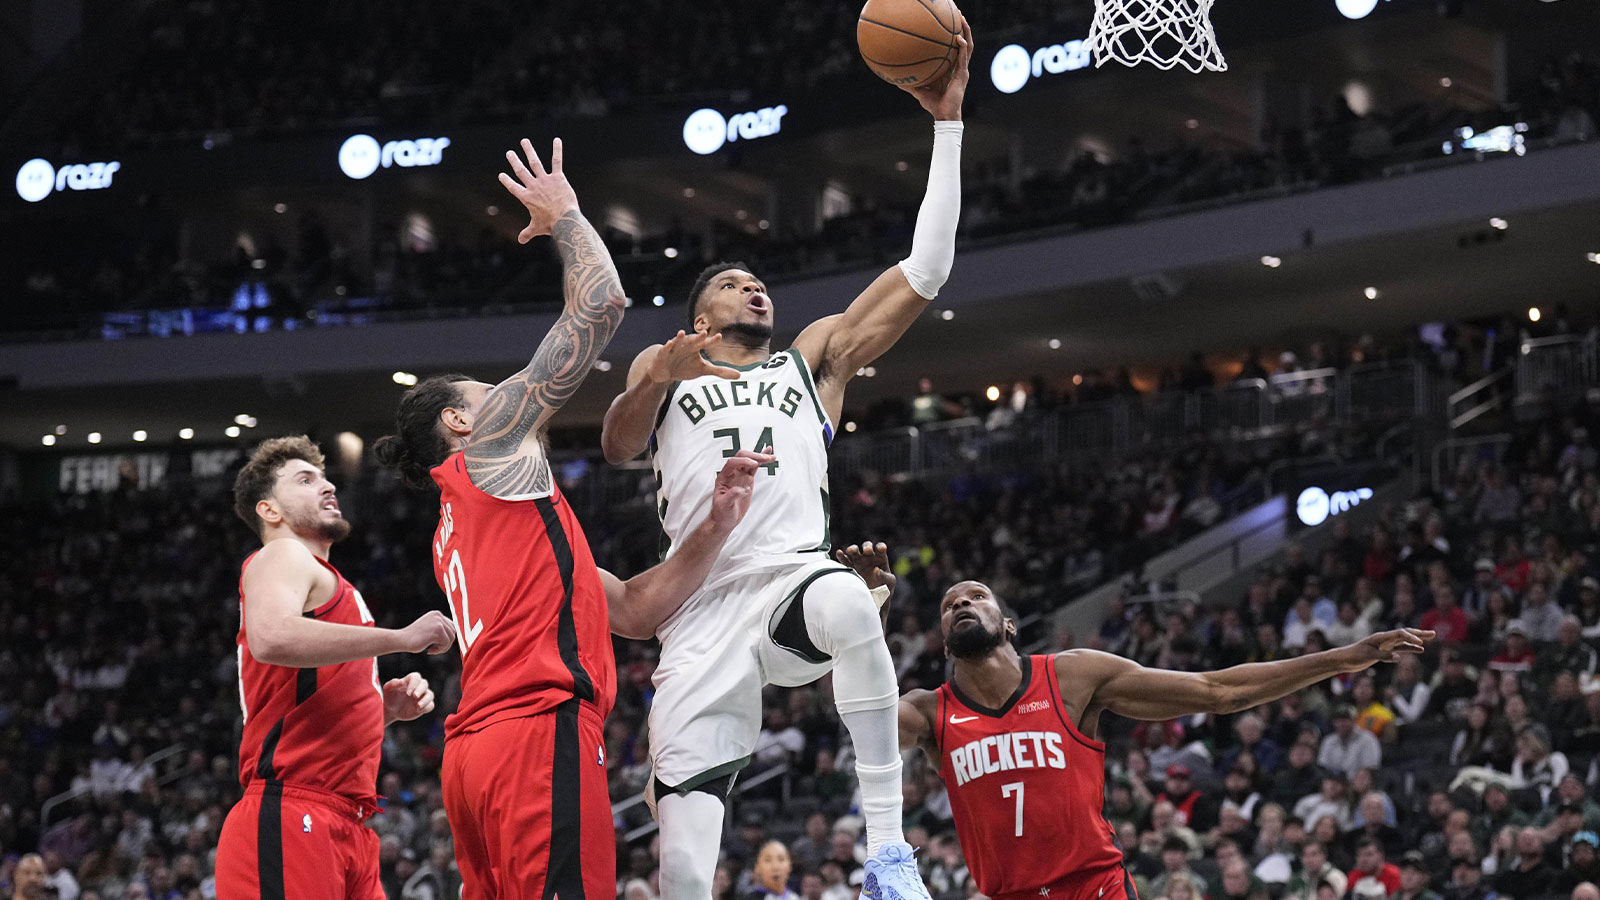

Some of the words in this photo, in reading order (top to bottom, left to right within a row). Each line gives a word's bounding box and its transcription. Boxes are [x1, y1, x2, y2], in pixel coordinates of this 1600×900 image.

[726, 104, 788, 143] razr
[381, 136, 451, 169] razr
[55, 161, 121, 192] razr
[678, 381, 803, 425] BUCKS
[443, 549, 484, 657] 12
[950, 731, 1067, 787] ROCKETS
[1001, 781, 1025, 837] 7
